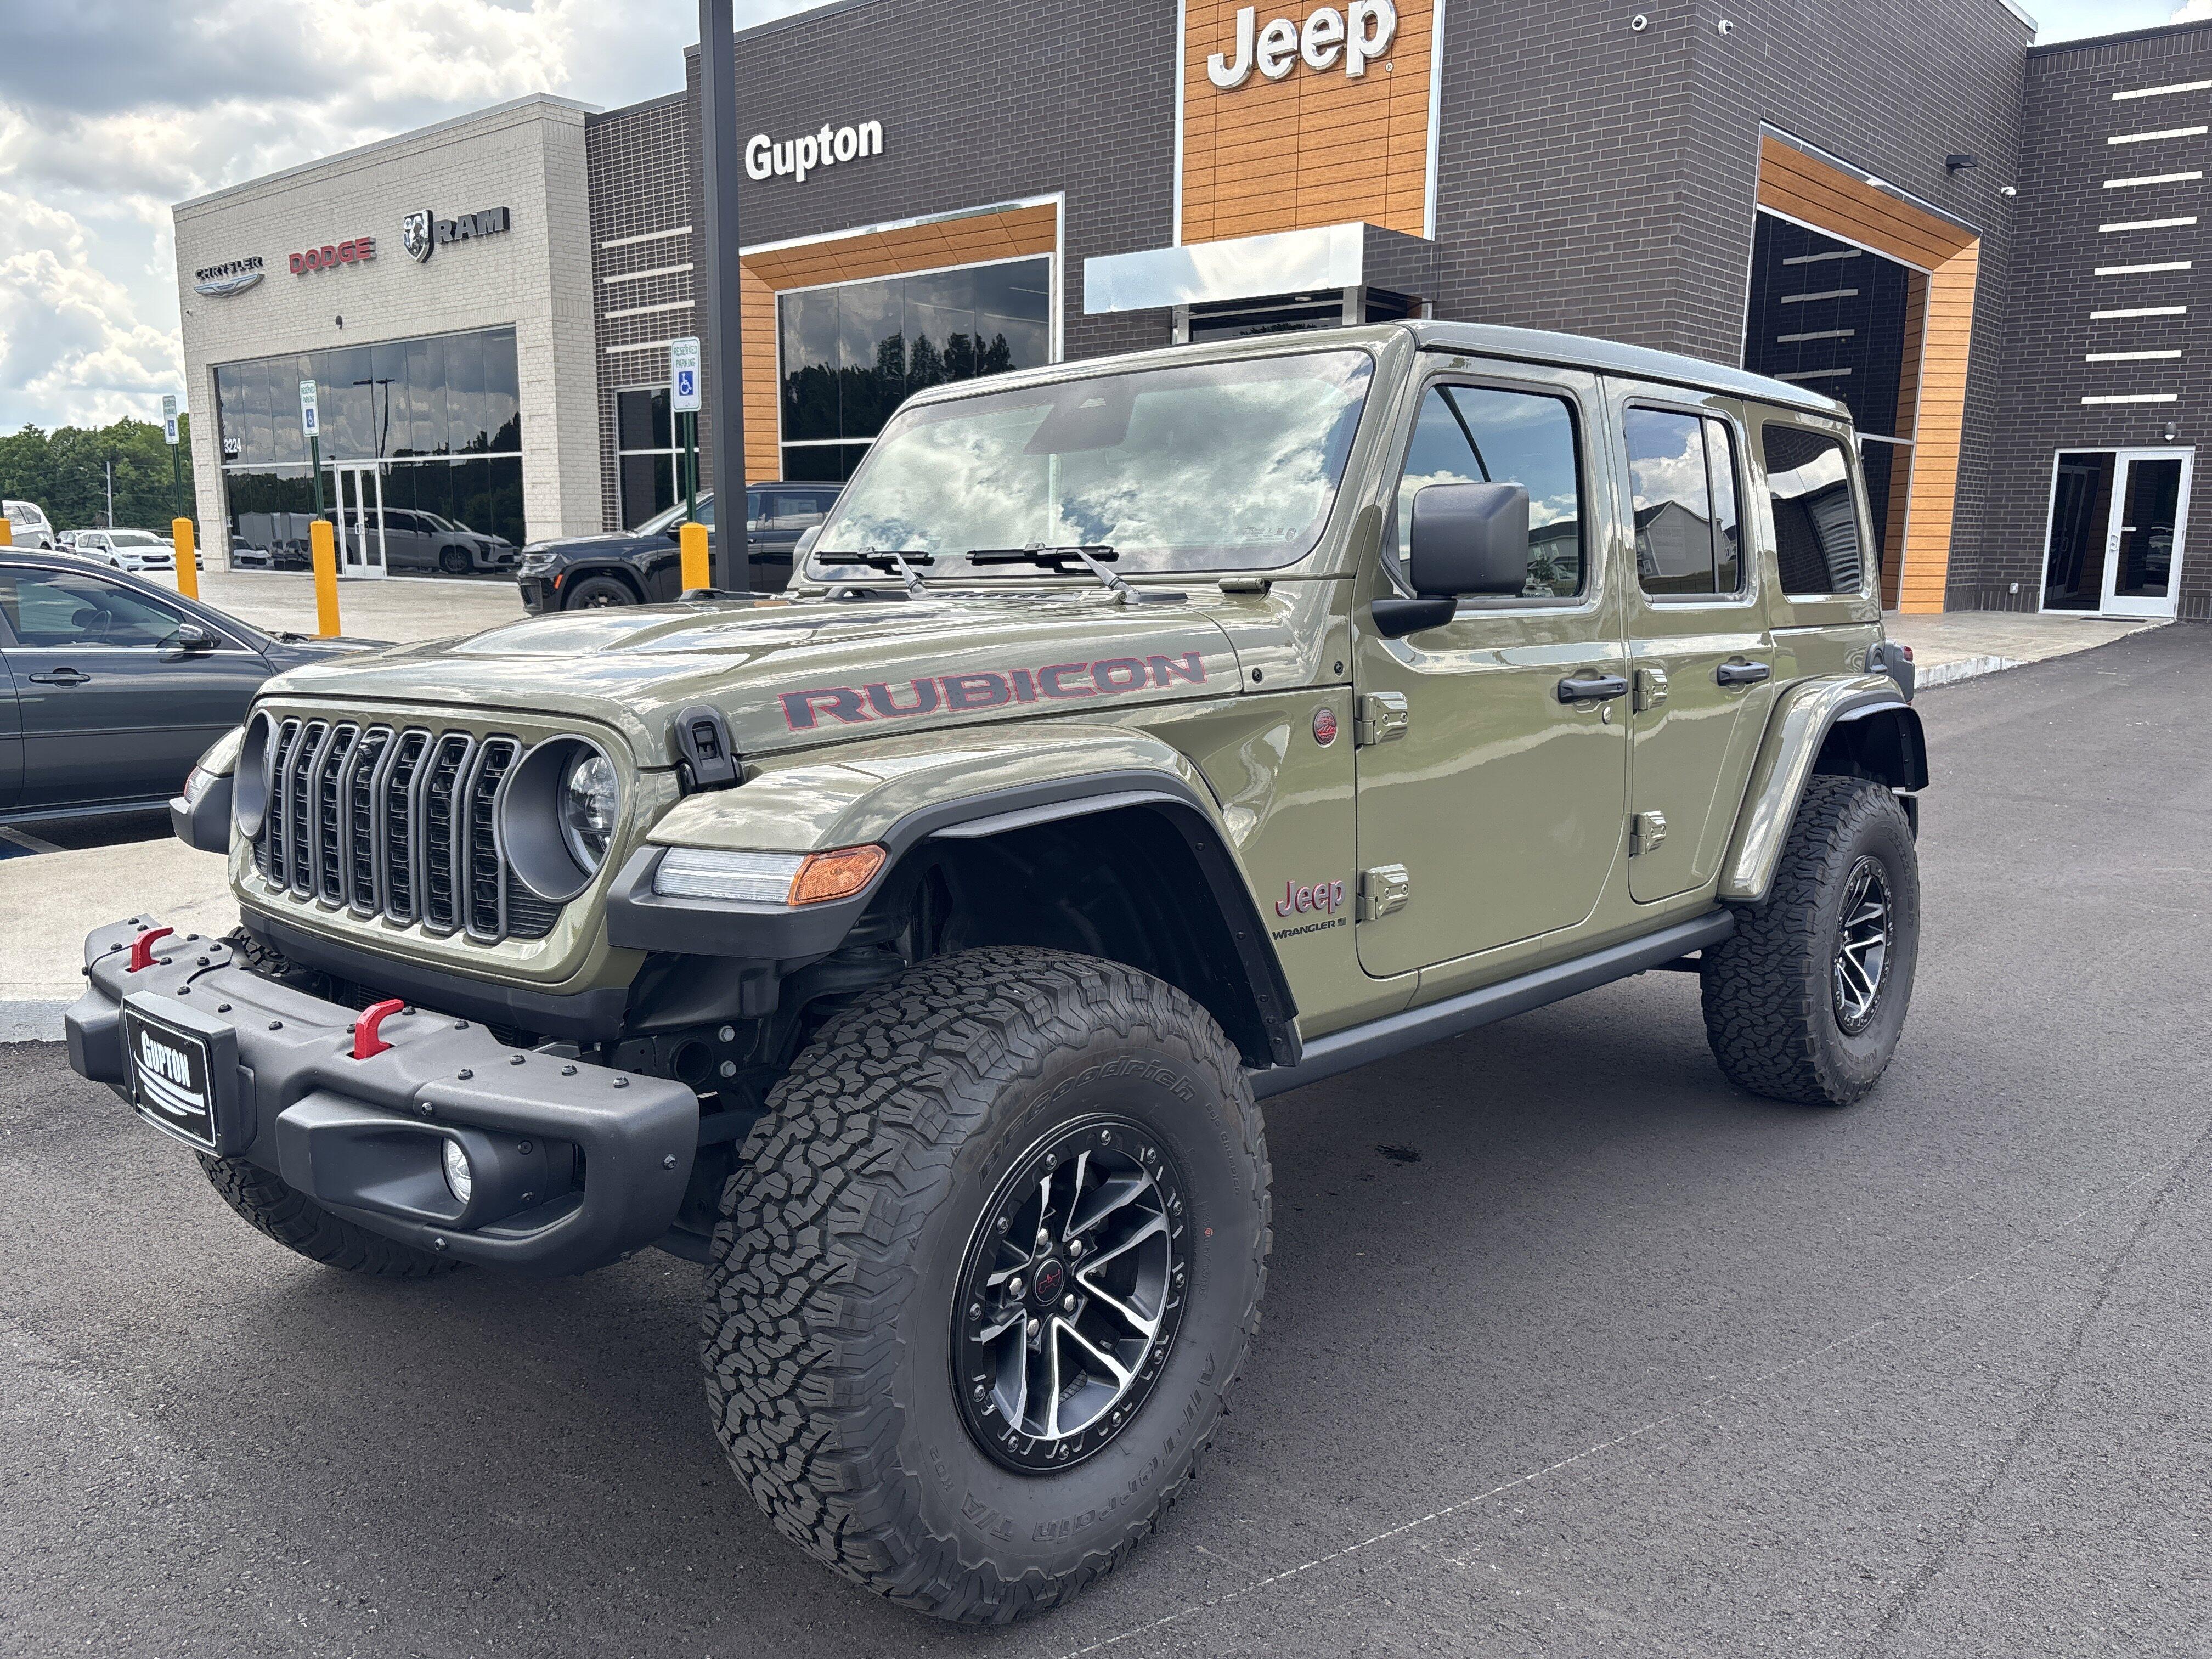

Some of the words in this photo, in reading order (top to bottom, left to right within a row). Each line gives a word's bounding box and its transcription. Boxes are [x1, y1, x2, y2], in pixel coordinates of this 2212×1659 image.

[1207, 0, 1397, 90] Jeep
[745, 120, 884, 183] Gupton
[433, 206, 510, 244] RAM
[195, 256, 263, 280] CHRYSLER
[289, 236, 376, 274] DODGE
[674, 346, 698, 356] RESERVED
[675, 358, 696, 368] PARKING
[224, 437, 242, 453] 3224
[777, 651, 1207, 731] RUBICON
[1275, 880, 1346, 917] Jeep
[1272, 919, 1336, 941] WRANGLER
[978, 1055, 1197, 1190] BFGoodrich
[1205, 1102, 1221, 1129] Baja
[1220, 1131, 1240, 1197] Champion
[1032, 1351, 1217, 1543] All-Terrain
[960, 1489, 1017, 1542] T/A
